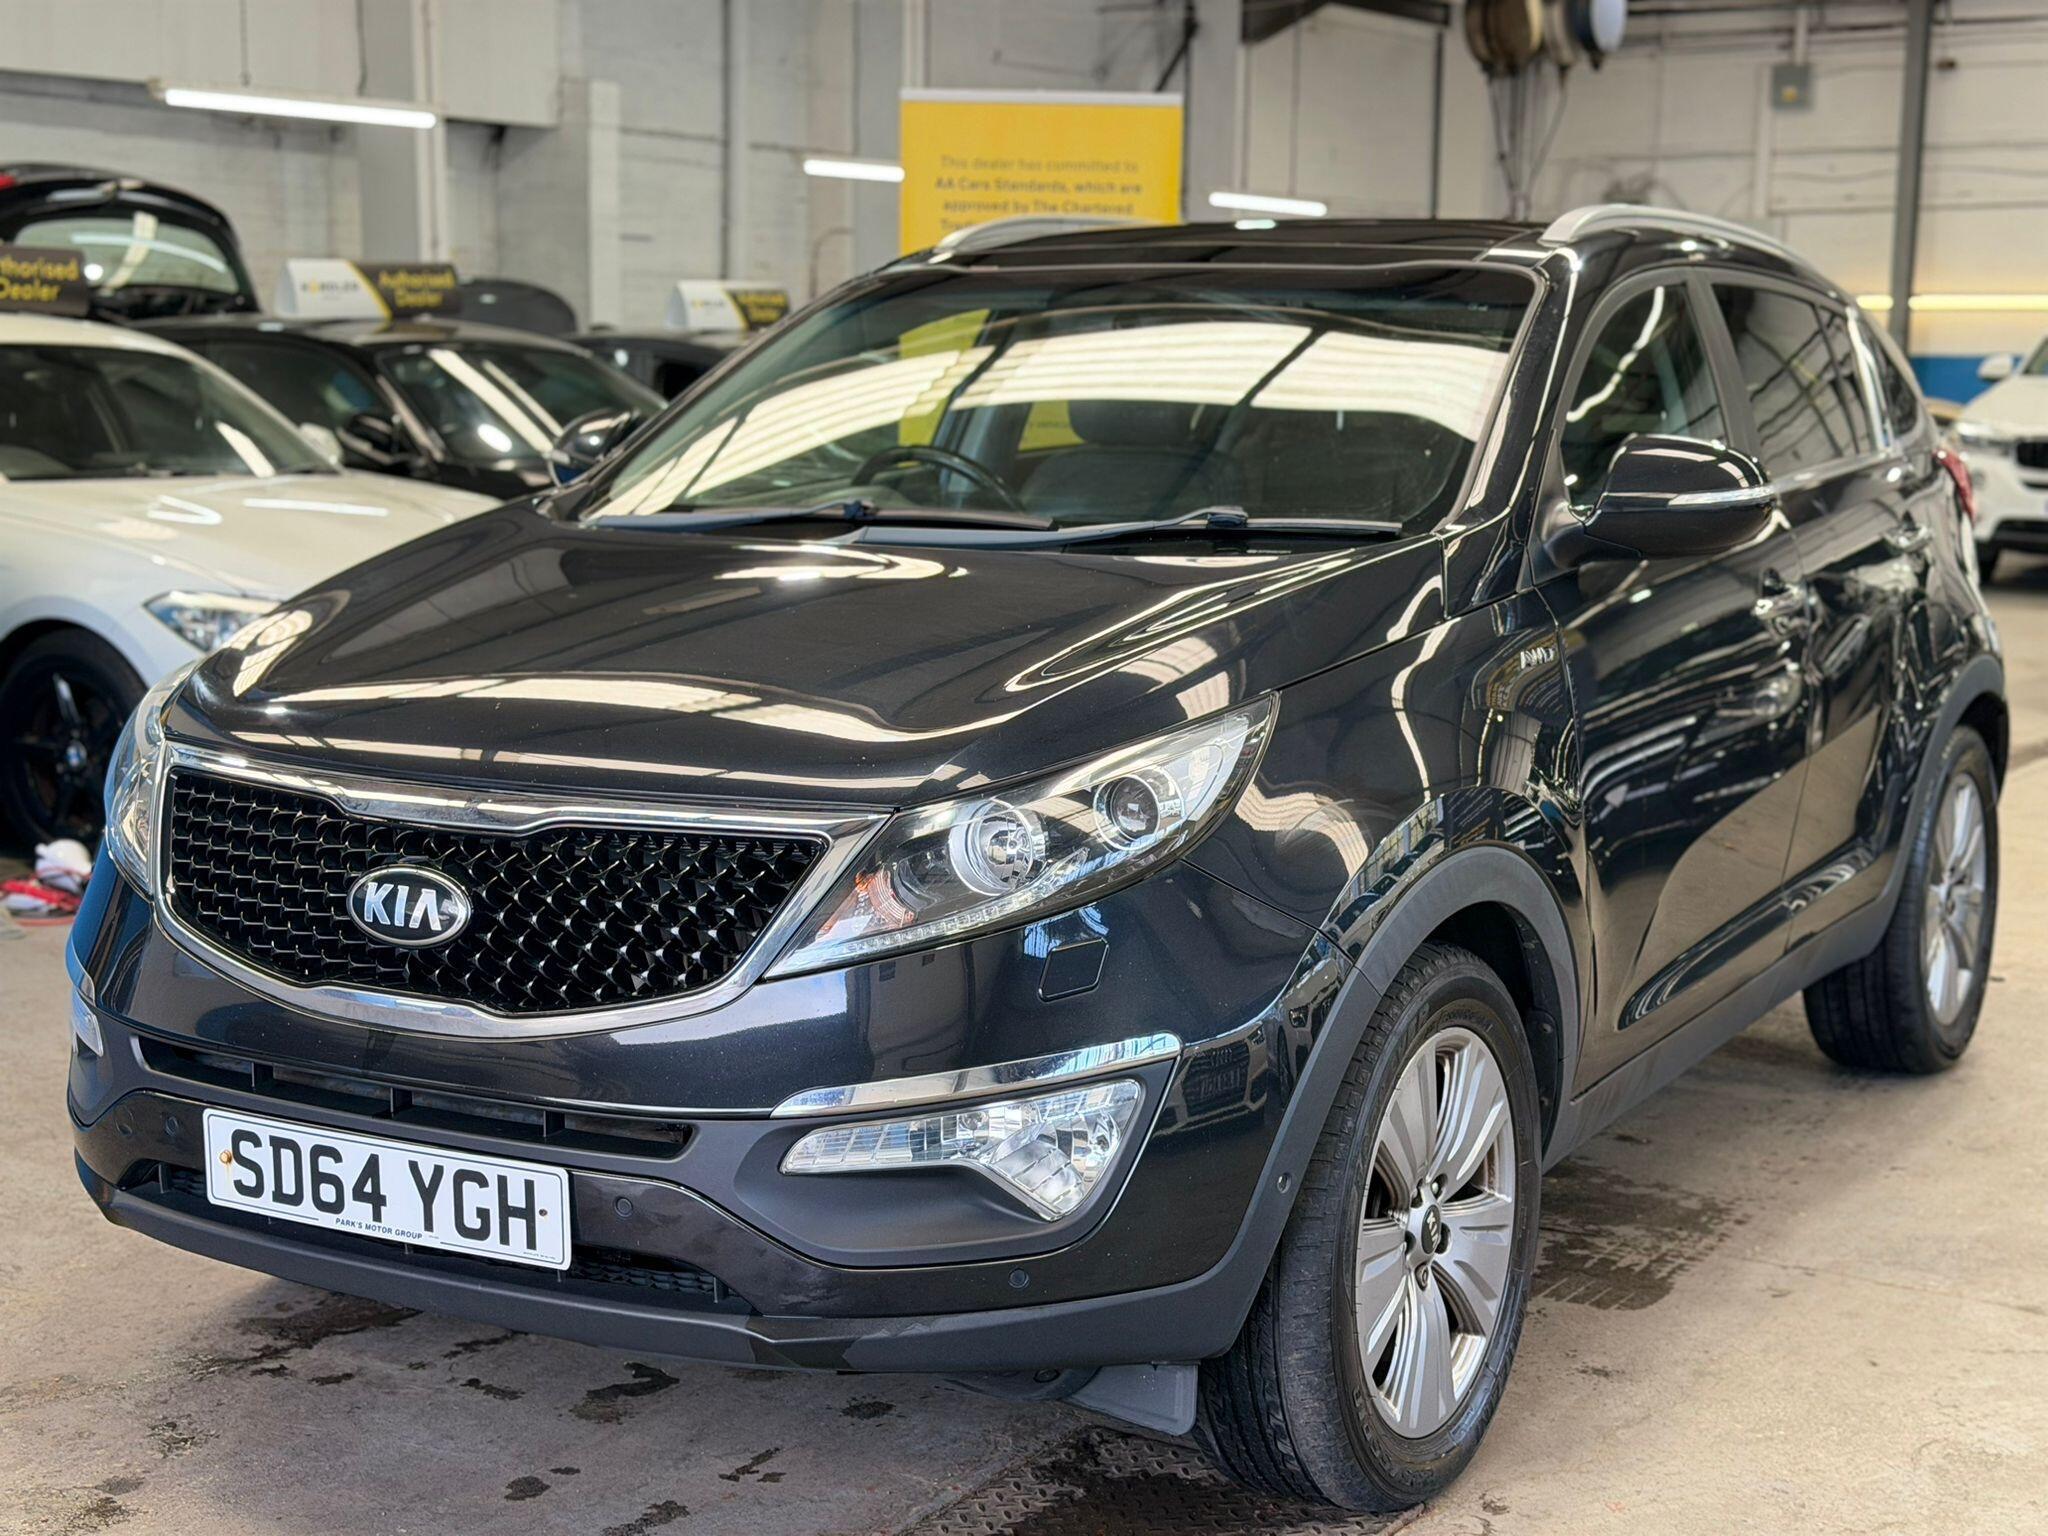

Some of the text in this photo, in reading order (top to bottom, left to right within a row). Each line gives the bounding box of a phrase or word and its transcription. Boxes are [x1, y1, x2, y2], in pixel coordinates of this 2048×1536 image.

[940, 155, 1138, 173] This dealer has committed to
[935, 178, 955, 191] AA
[1074, 179, 1115, 193] which
[1119, 182, 1142, 194] are
[1012, 200, 1029, 216] by
[1032, 200, 1059, 214] The
[1061, 201, 1135, 215] Chartered
[364, 881, 442, 931] KIA
[231, 1128, 537, 1251] SD64 YGH
[335, 1217, 364, 1229] PARK'S
[364, 1223, 393, 1235] MOTOR
[394, 1228, 423, 1241] GROUP
